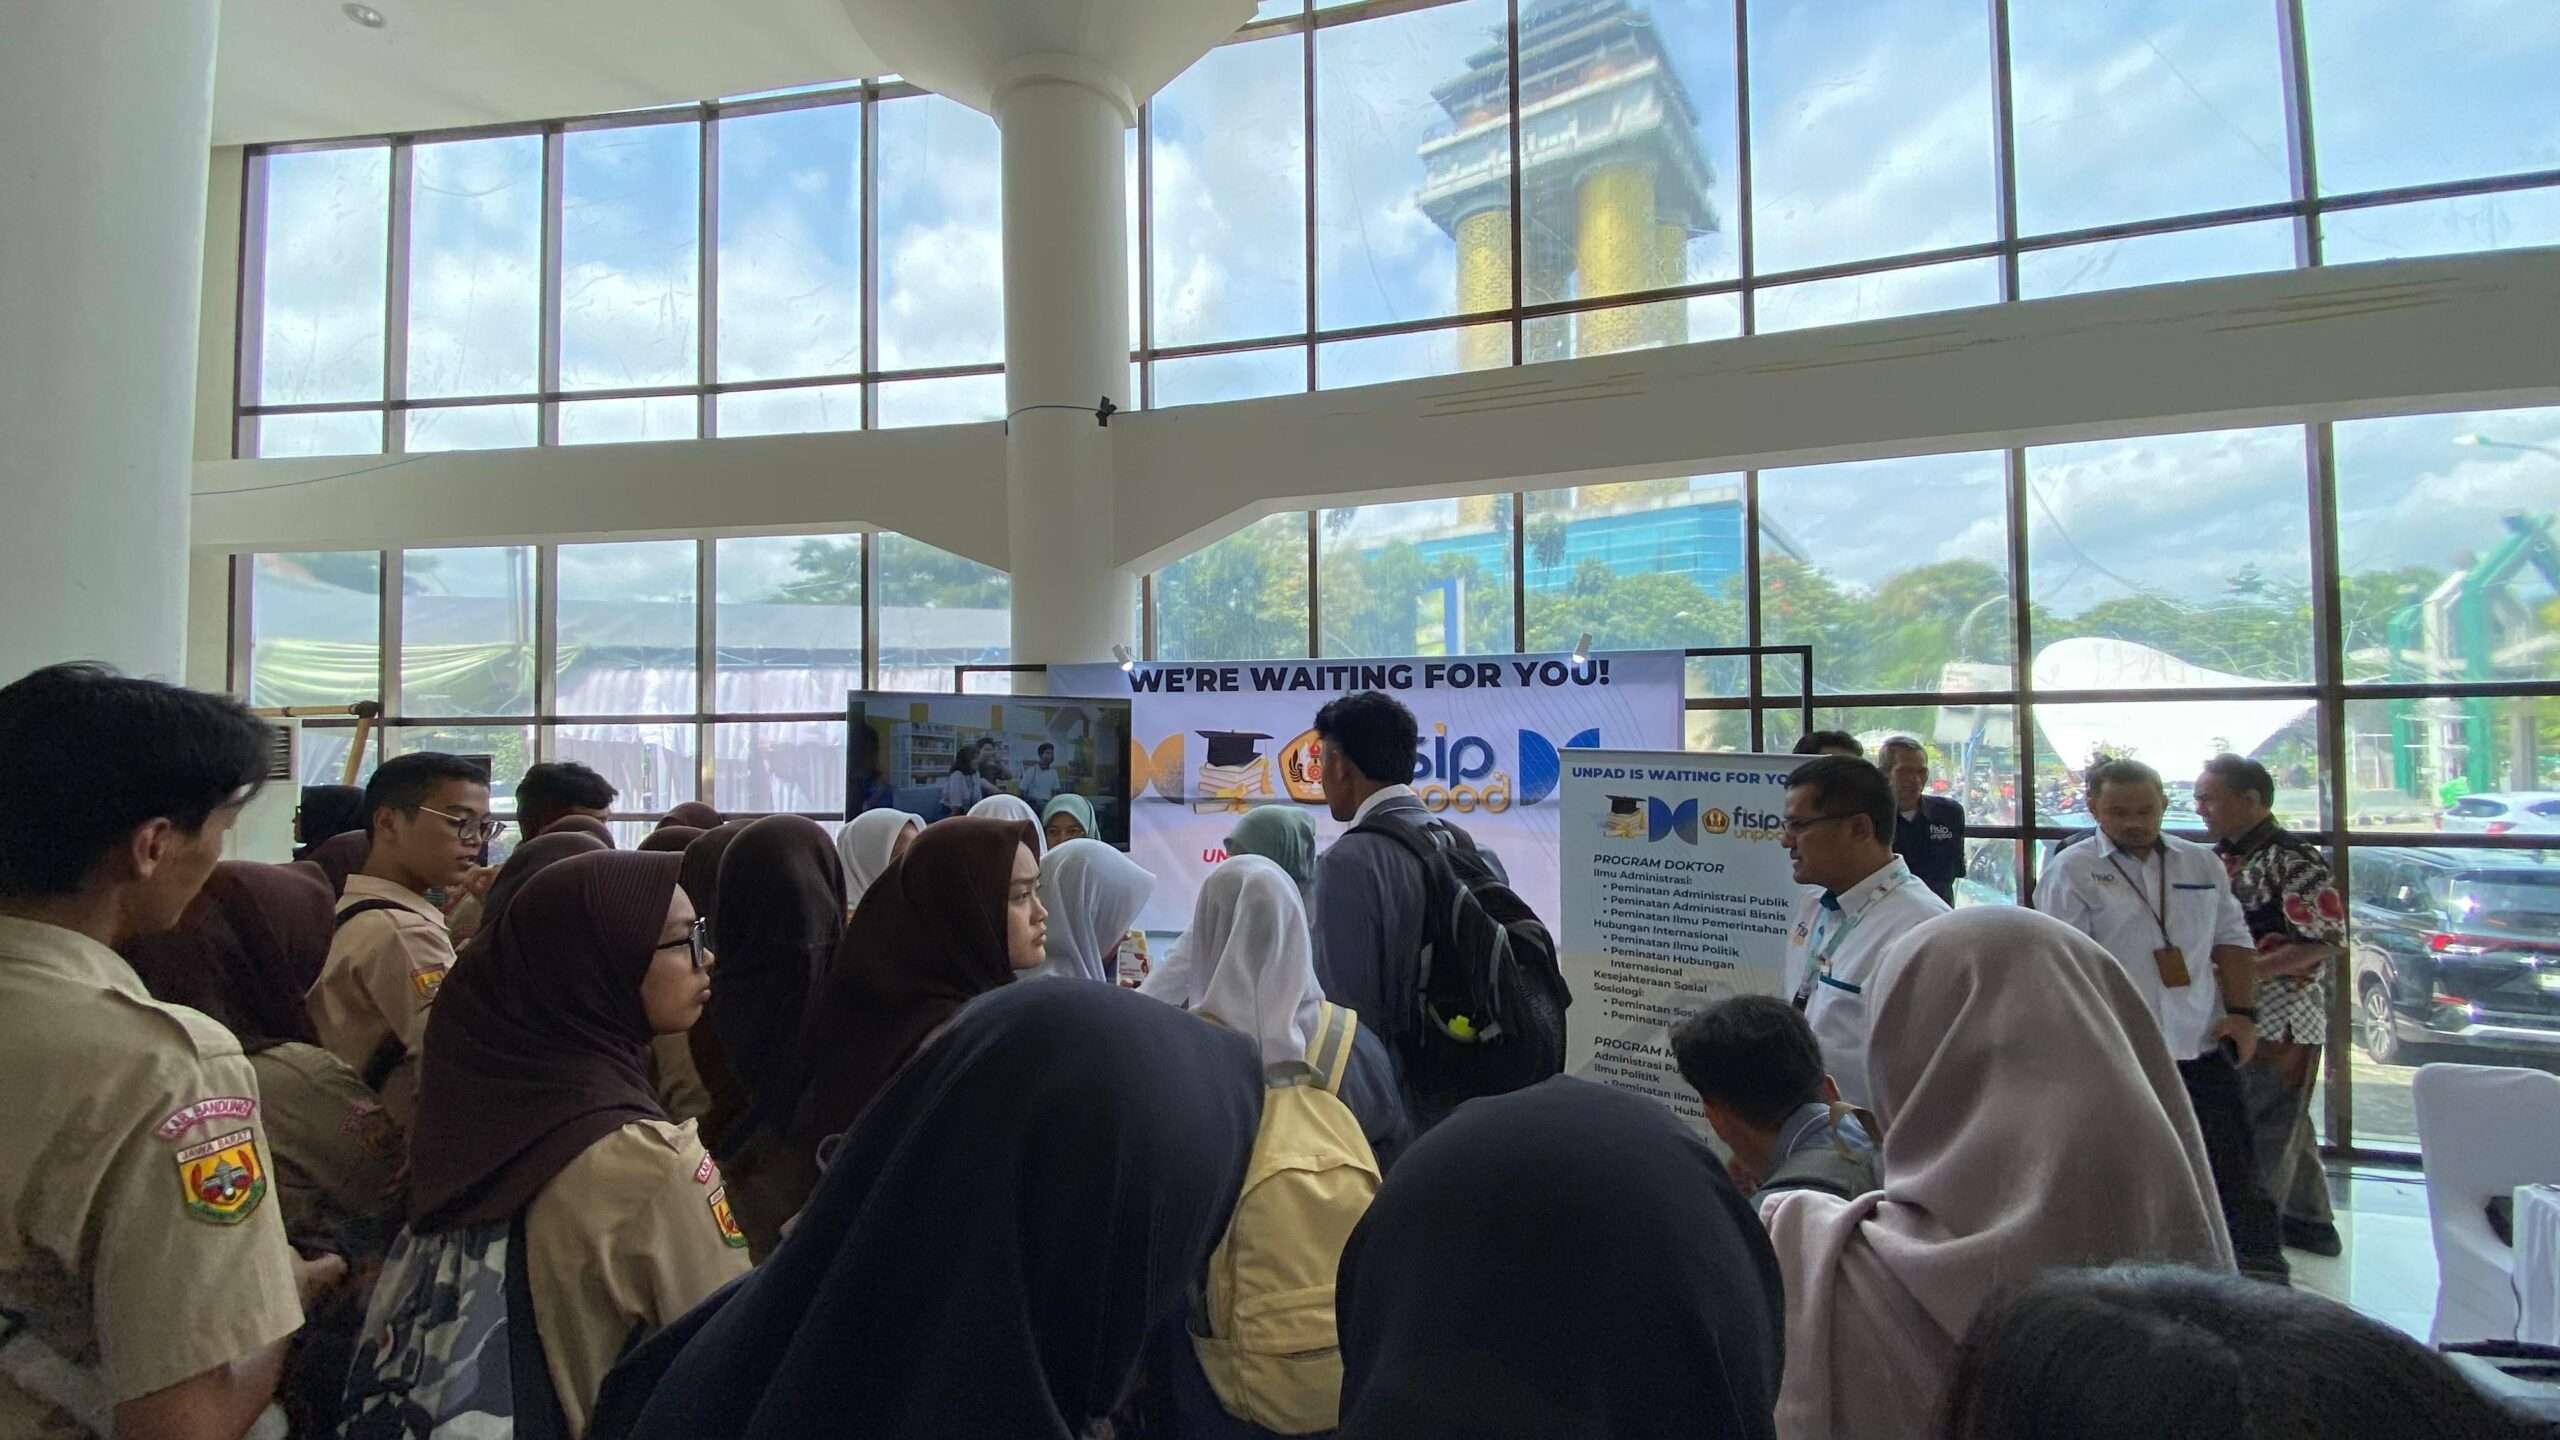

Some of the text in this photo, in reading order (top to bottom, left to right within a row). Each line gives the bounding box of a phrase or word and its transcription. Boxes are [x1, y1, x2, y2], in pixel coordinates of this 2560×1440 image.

[1129, 659, 1610, 693] WE'RE WAITING FOR YOU!
[1572, 767, 1790, 785] UNPAD IS WAITING FOR YO
[1733, 806, 1780, 831] fisip
[1202, 849, 1229, 863] UN
[1593, 854, 1725, 873] PROGRAM DOKTOR
[1593, 868, 1617, 878] Ilmu
[1610, 883, 1789, 908] Peminatan Administrasi Publik
[1610, 895, 1786, 921] Peminatan Administrasi Bisnis
[1593, 919, 1728, 942] Hubungan Internasional
[1610, 908, 1670, 923] Peminatan
[1673, 914, 1699, 926] Ilmu
[1702, 918, 1788, 935] Pemerintahan
[1610, 933, 1740, 957] Peminatan Ilmu Politik
[1610, 946, 1735, 970] Peminatan Hubungan
[1610, 960, 1683, 977] Internasional
[1593, 969, 1708, 993] Kesejahteraan Sosial
[1611, 998, 1697, 1018] Peminatan Sos
[1611, 1010, 1671, 1027] Peminatan
[1594, 1036, 1662, 1056] PROGRAM
[1594, 1051, 1680, 1074] Administrasi Pu
[1594, 1064, 1618, 1075] Ilmu
[1674, 1091, 1700, 1104] Ilmu
[192, 1100, 249, 1118] BANDUNG
[1674, 1105, 1705, 1119] Hubu
